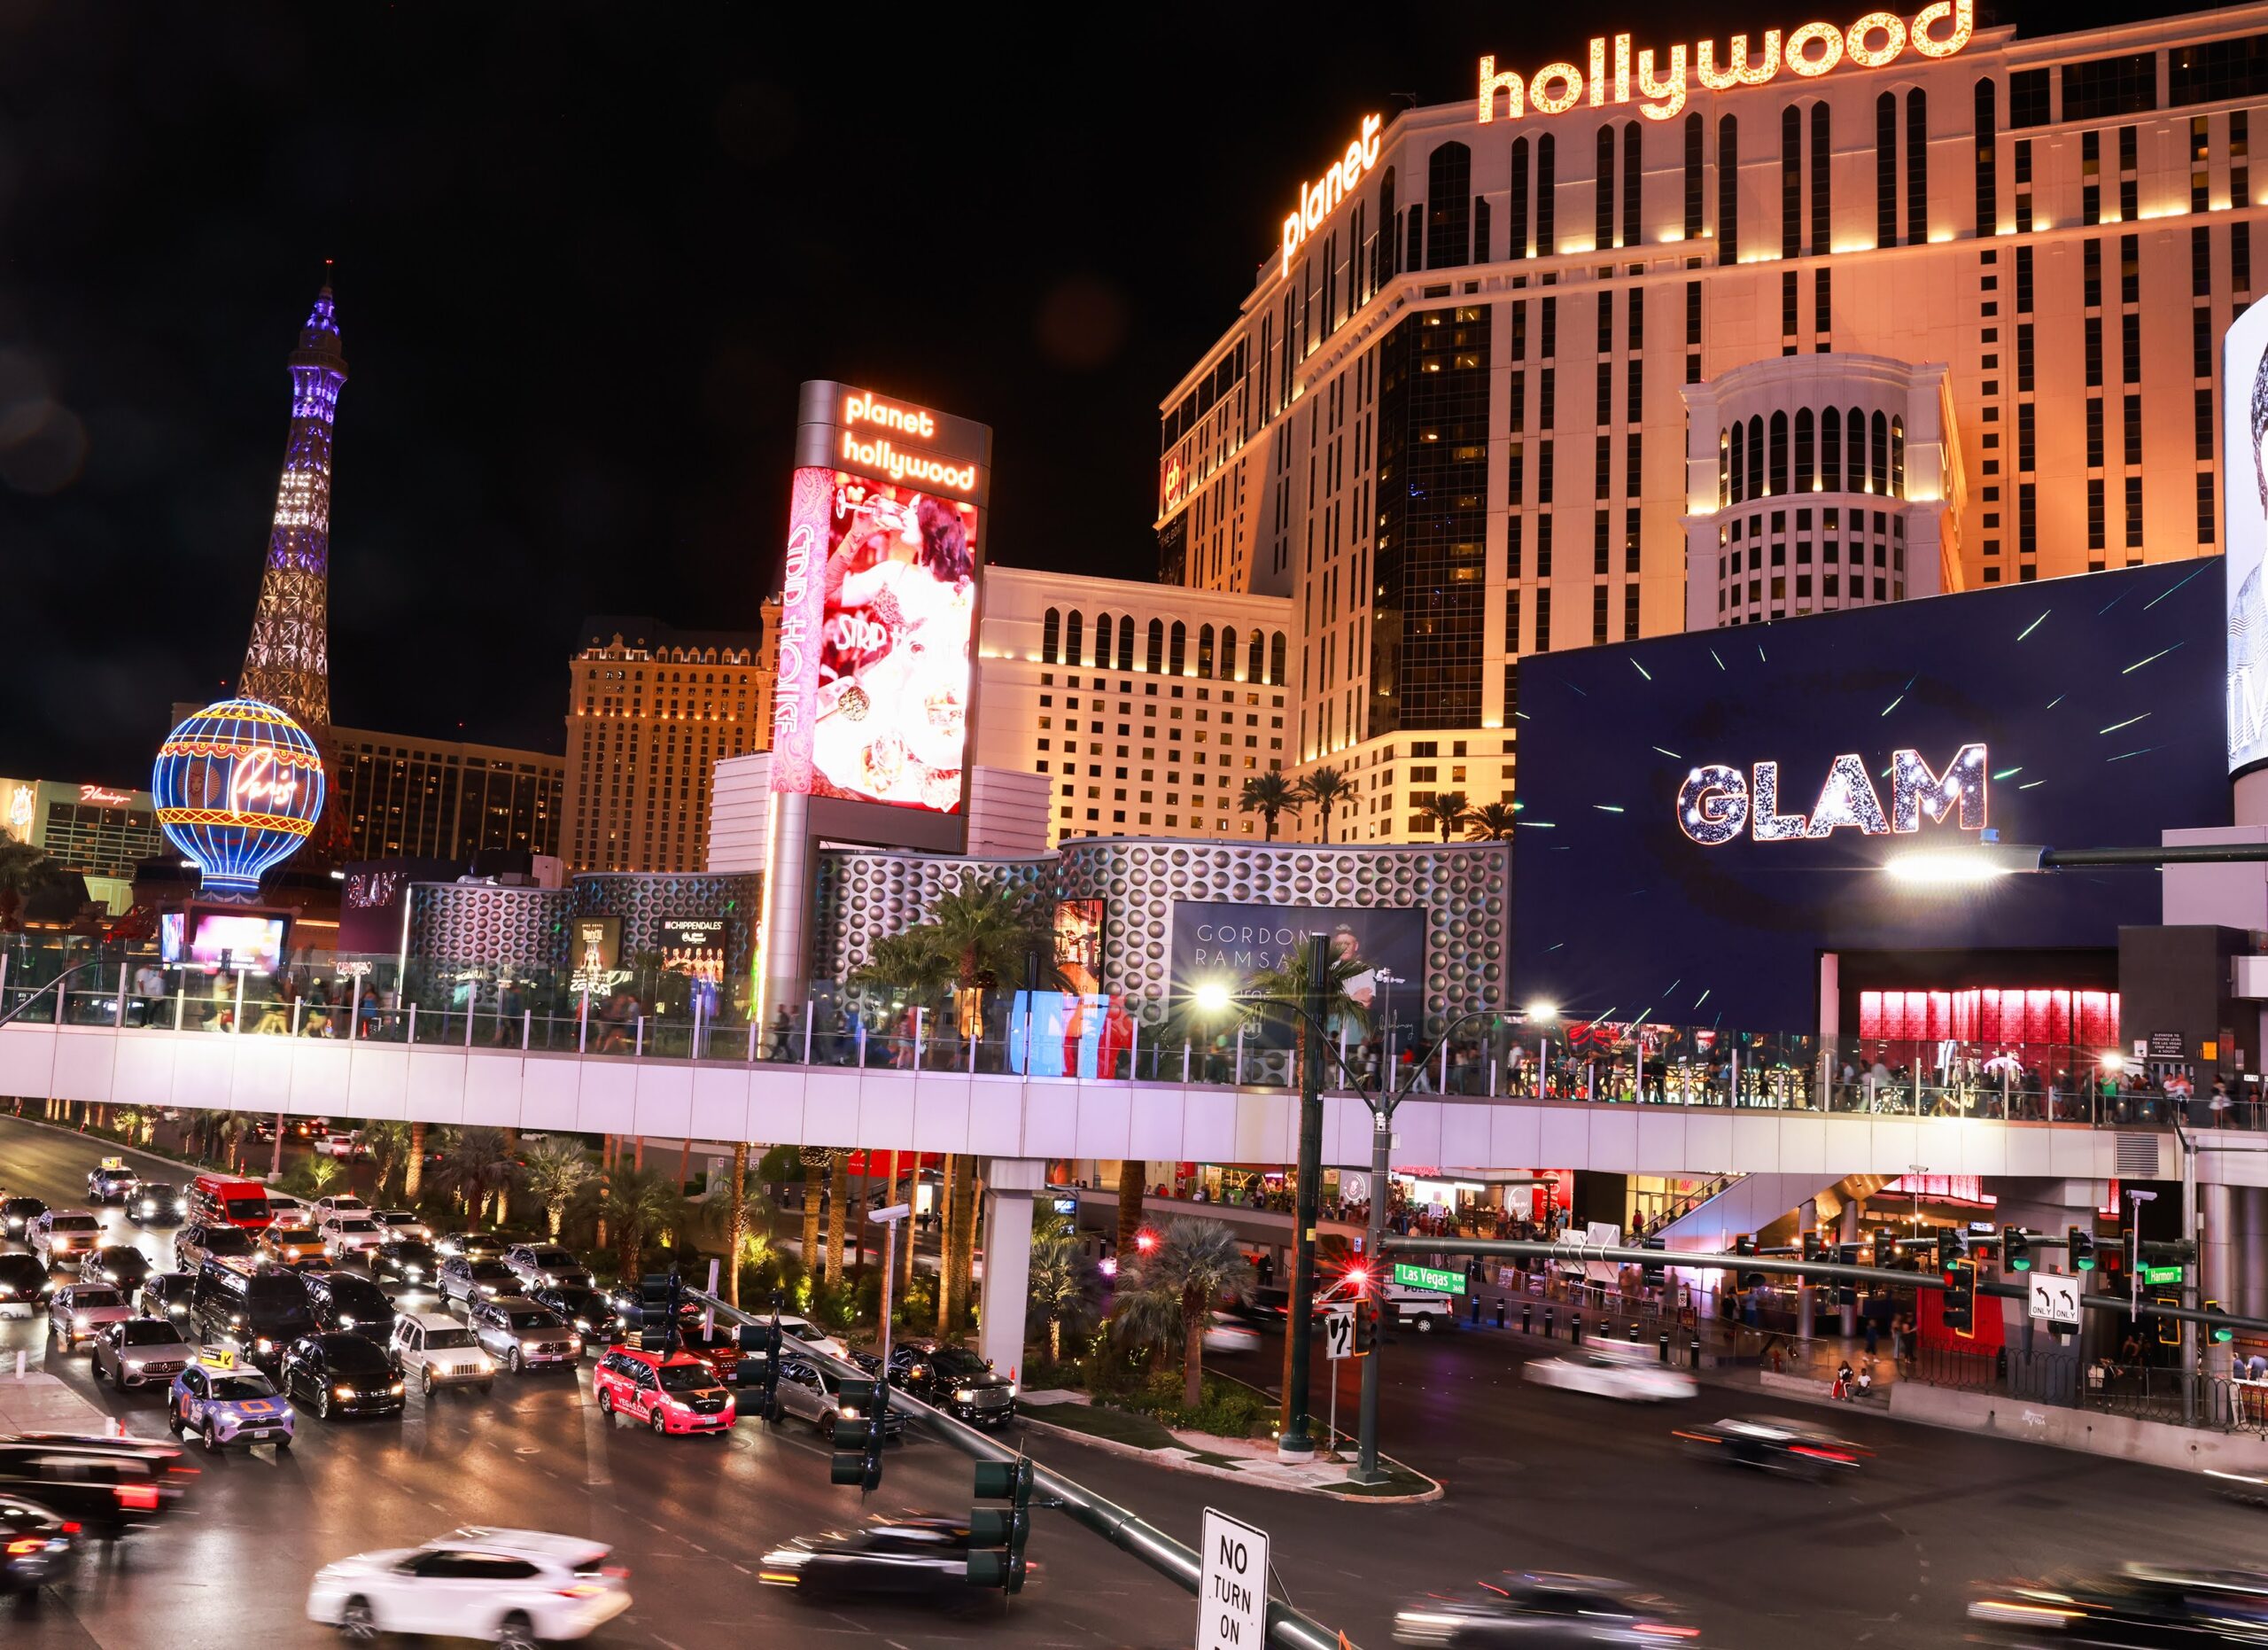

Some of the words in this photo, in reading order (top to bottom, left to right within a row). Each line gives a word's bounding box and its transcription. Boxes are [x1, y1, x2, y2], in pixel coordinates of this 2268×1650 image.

[1282, 113, 1380, 278] planet
[1478, 0, 1973, 124] hollywood
[846, 394, 934, 437] planet
[843, 433, 975, 490] hollywood
[835, 613, 888, 652] STRIP
[81, 784, 132, 805] Flamingo
[230, 747, 298, 819] Paris
[1676, 743, 1988, 847] GLAM
[348, 871, 397, 909] GLAM
[671, 921, 723, 930] CHIPPENDALES
[1196, 924, 1312, 946] GORDON
[1195, 948, 1290, 969] RAMSA
[1402, 1265, 1418, 1281] Las
[1420, 1268, 1449, 1289] Vegas
[2150, 1270, 2175, 1282] Harmon
[2032, 1306, 2052, 1316] ONLY
[2056, 1310, 2076, 1319] ONLY
[1220, 1535, 1247, 1575] NO
[1215, 1574, 1251, 1615] TURN
[1221, 1615, 1239, 1646] ON
